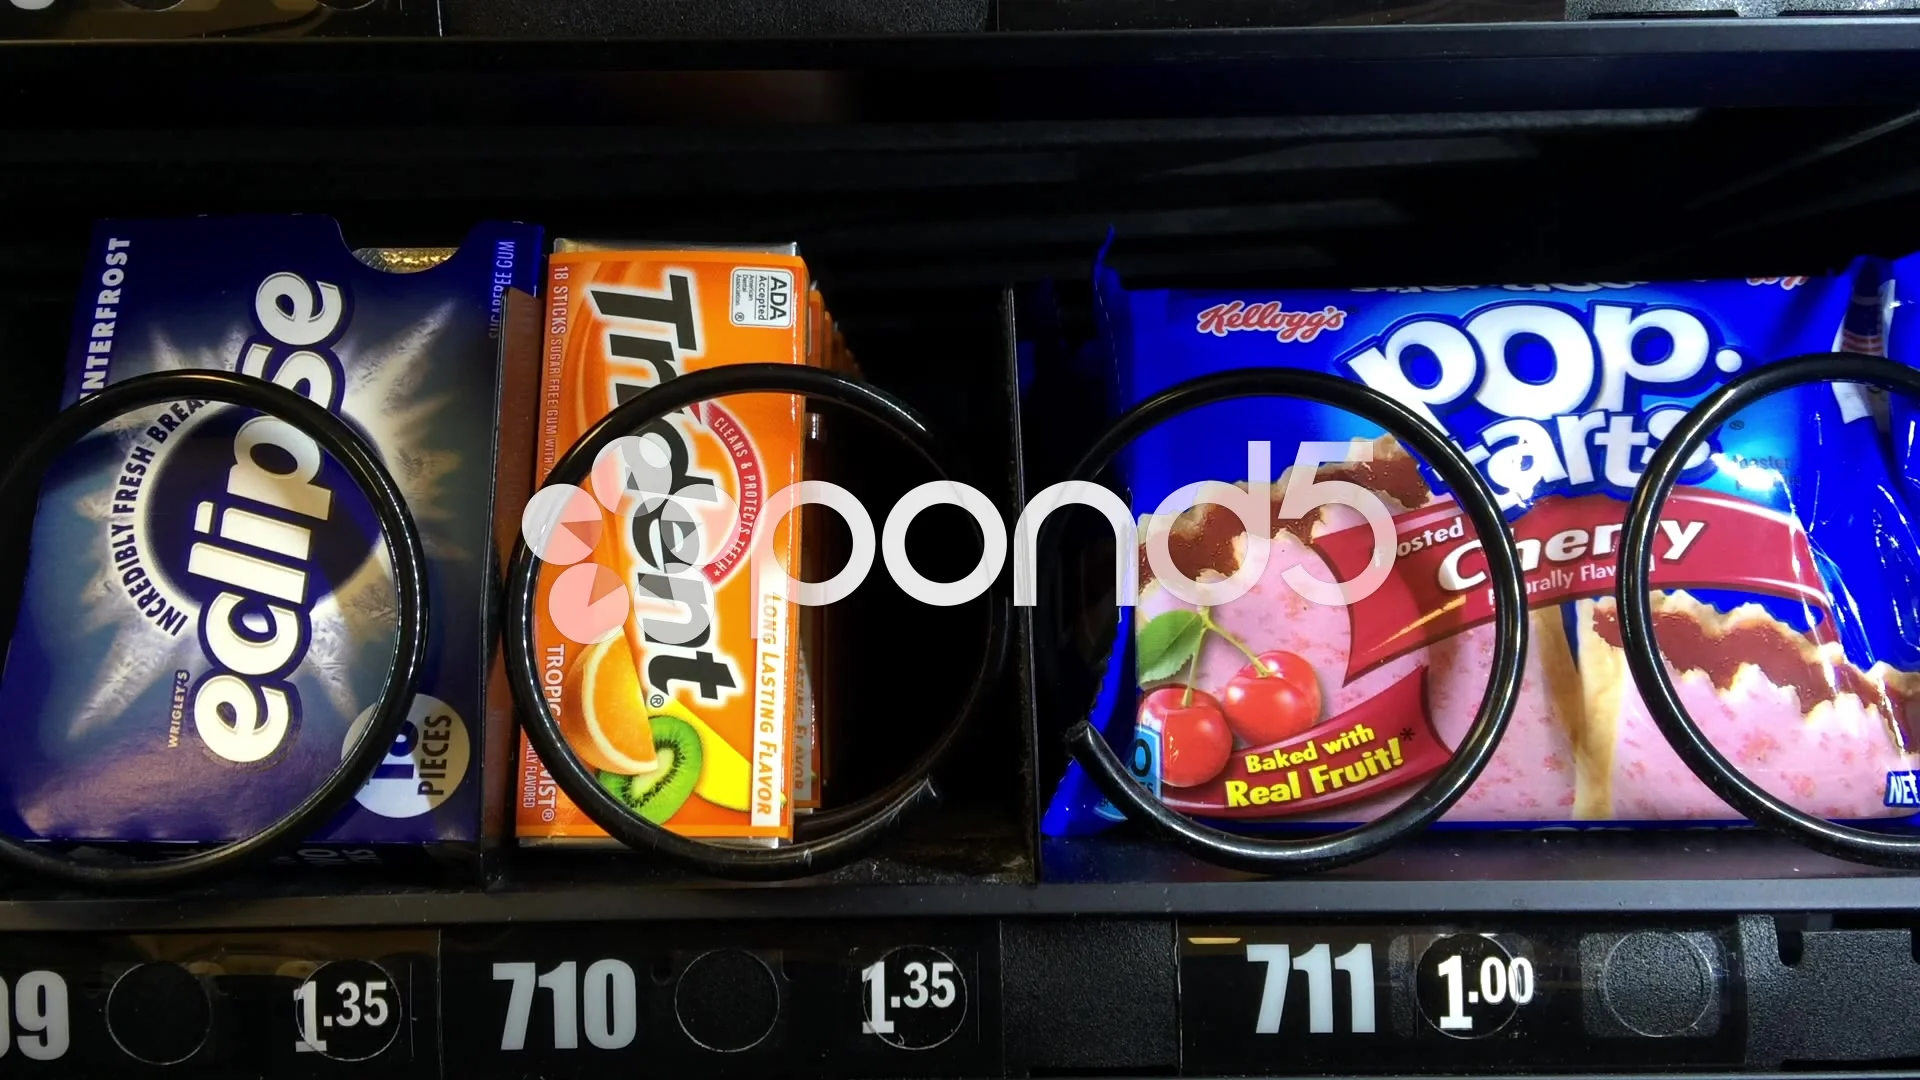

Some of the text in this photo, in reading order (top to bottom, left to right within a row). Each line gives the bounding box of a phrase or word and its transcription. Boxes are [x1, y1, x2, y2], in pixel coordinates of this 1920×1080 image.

[496, 241, 516, 269] GUM
[554, 266, 569, 280] 18
[80, 237, 131, 400] NTERFROST
[550, 285, 568, 335] STICKS
[755, 275, 769, 321] Accepted
[770, 276, 788, 320] ADA
[1197, 301, 1346, 341] Kellogg's
[549, 338, 562, 378] SUGAR
[545, 408, 559, 435] GUM
[547, 379, 560, 406] FREE
[543, 438, 556, 465] WITH
[713, 416, 748, 458] CLEANS
[740, 461, 753, 471] &
[1430, 408, 1713, 513] arts
[111, 399, 210, 637] INCREDIBLY FRESH BREA
[187, 271, 343, 763] eclipse
[589, 274, 737, 708] Trdent®
[738, 474, 758, 536] PROTECTS
[1437, 519, 1705, 592] Chery
[167, 671, 188, 749] WRIGLEY'S
[545, 643, 565, 727] TROPIC
[756, 593, 783, 816] LONG LASTING FLAVOR
[417, 715, 453, 796] PIECES
[1246, 724, 1375, 774] Baked with
[523, 766, 539, 808] FLAVORED
[1224, 769, 1301, 808] Real
[0, 970, 70, 1061] 9
[293, 980, 389, 1052] 1.35
[492, 958, 637, 1049] 710
[861, 962, 957, 1034] 1.35
[1246, 943, 1375, 1033] 711
[1437, 954, 1535, 1029] 1.00
